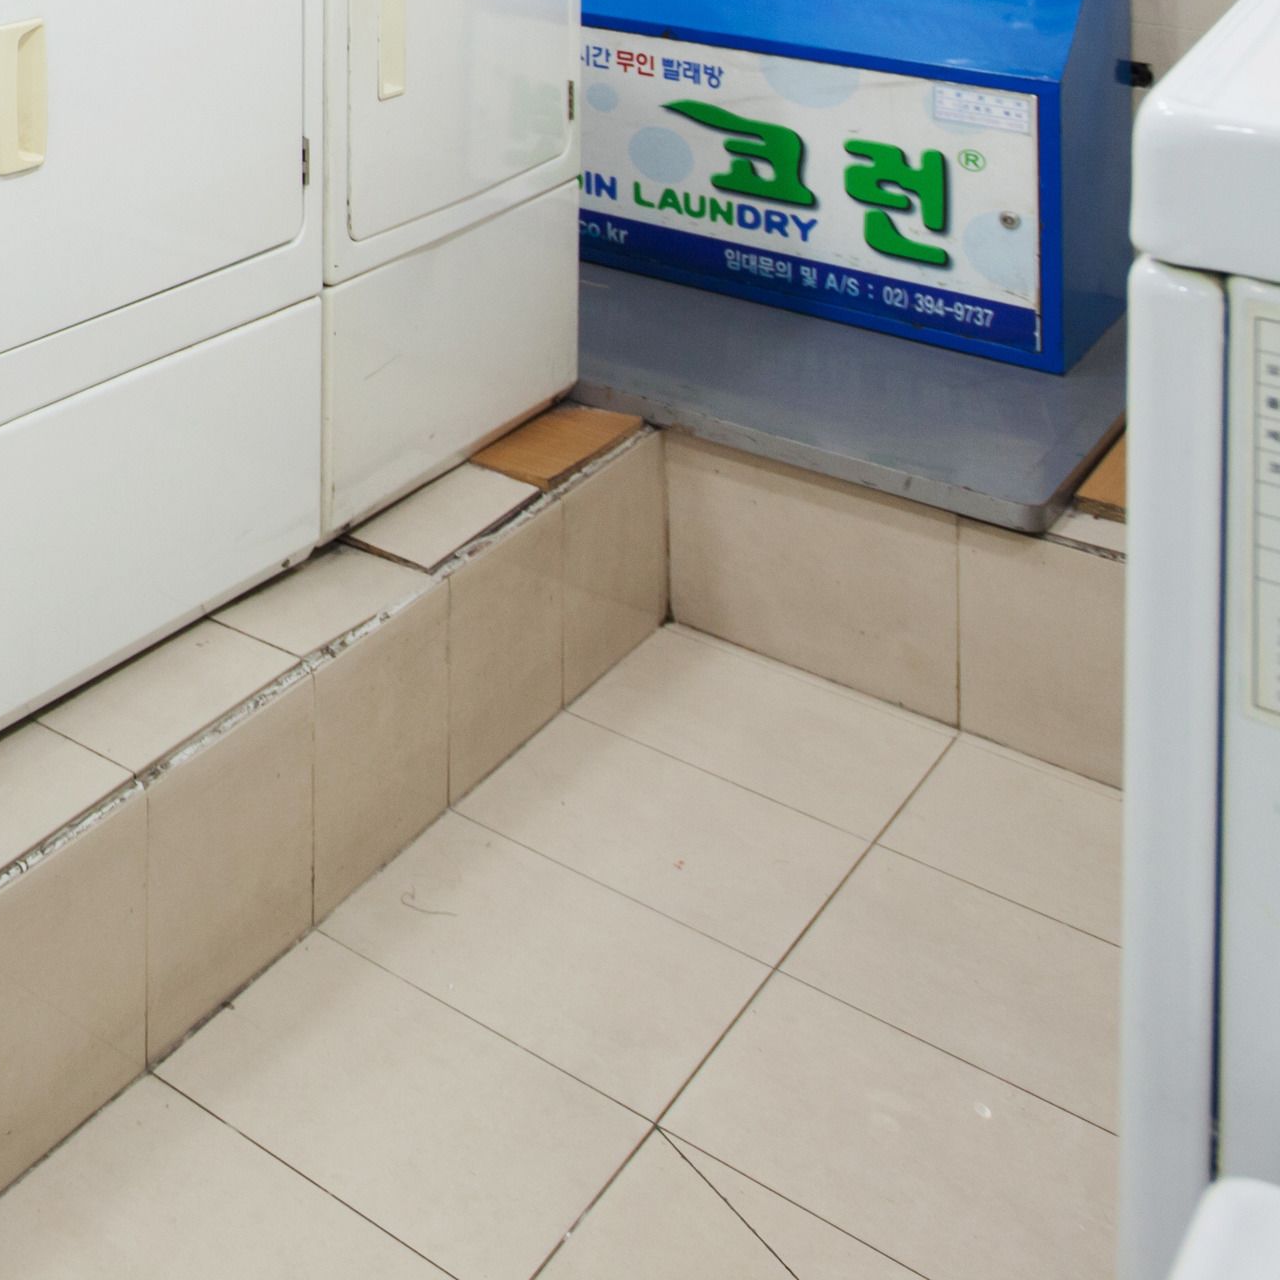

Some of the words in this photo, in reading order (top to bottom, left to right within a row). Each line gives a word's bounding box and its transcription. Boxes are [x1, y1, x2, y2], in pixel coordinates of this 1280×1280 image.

[615, 48, 656, 77] 무인
[660, 56, 724, 90] 빨래방
[576, 170, 618, 201] IN
[633, 179, 819, 244] LAUNDRY
[723, 248, 793, 284] 임대문의
[799, 265, 819, 290] 및
[824, 271, 860, 297] A/S
[881, 286, 911, 310] 02)
[913, 293, 995, 328] 394-9737
